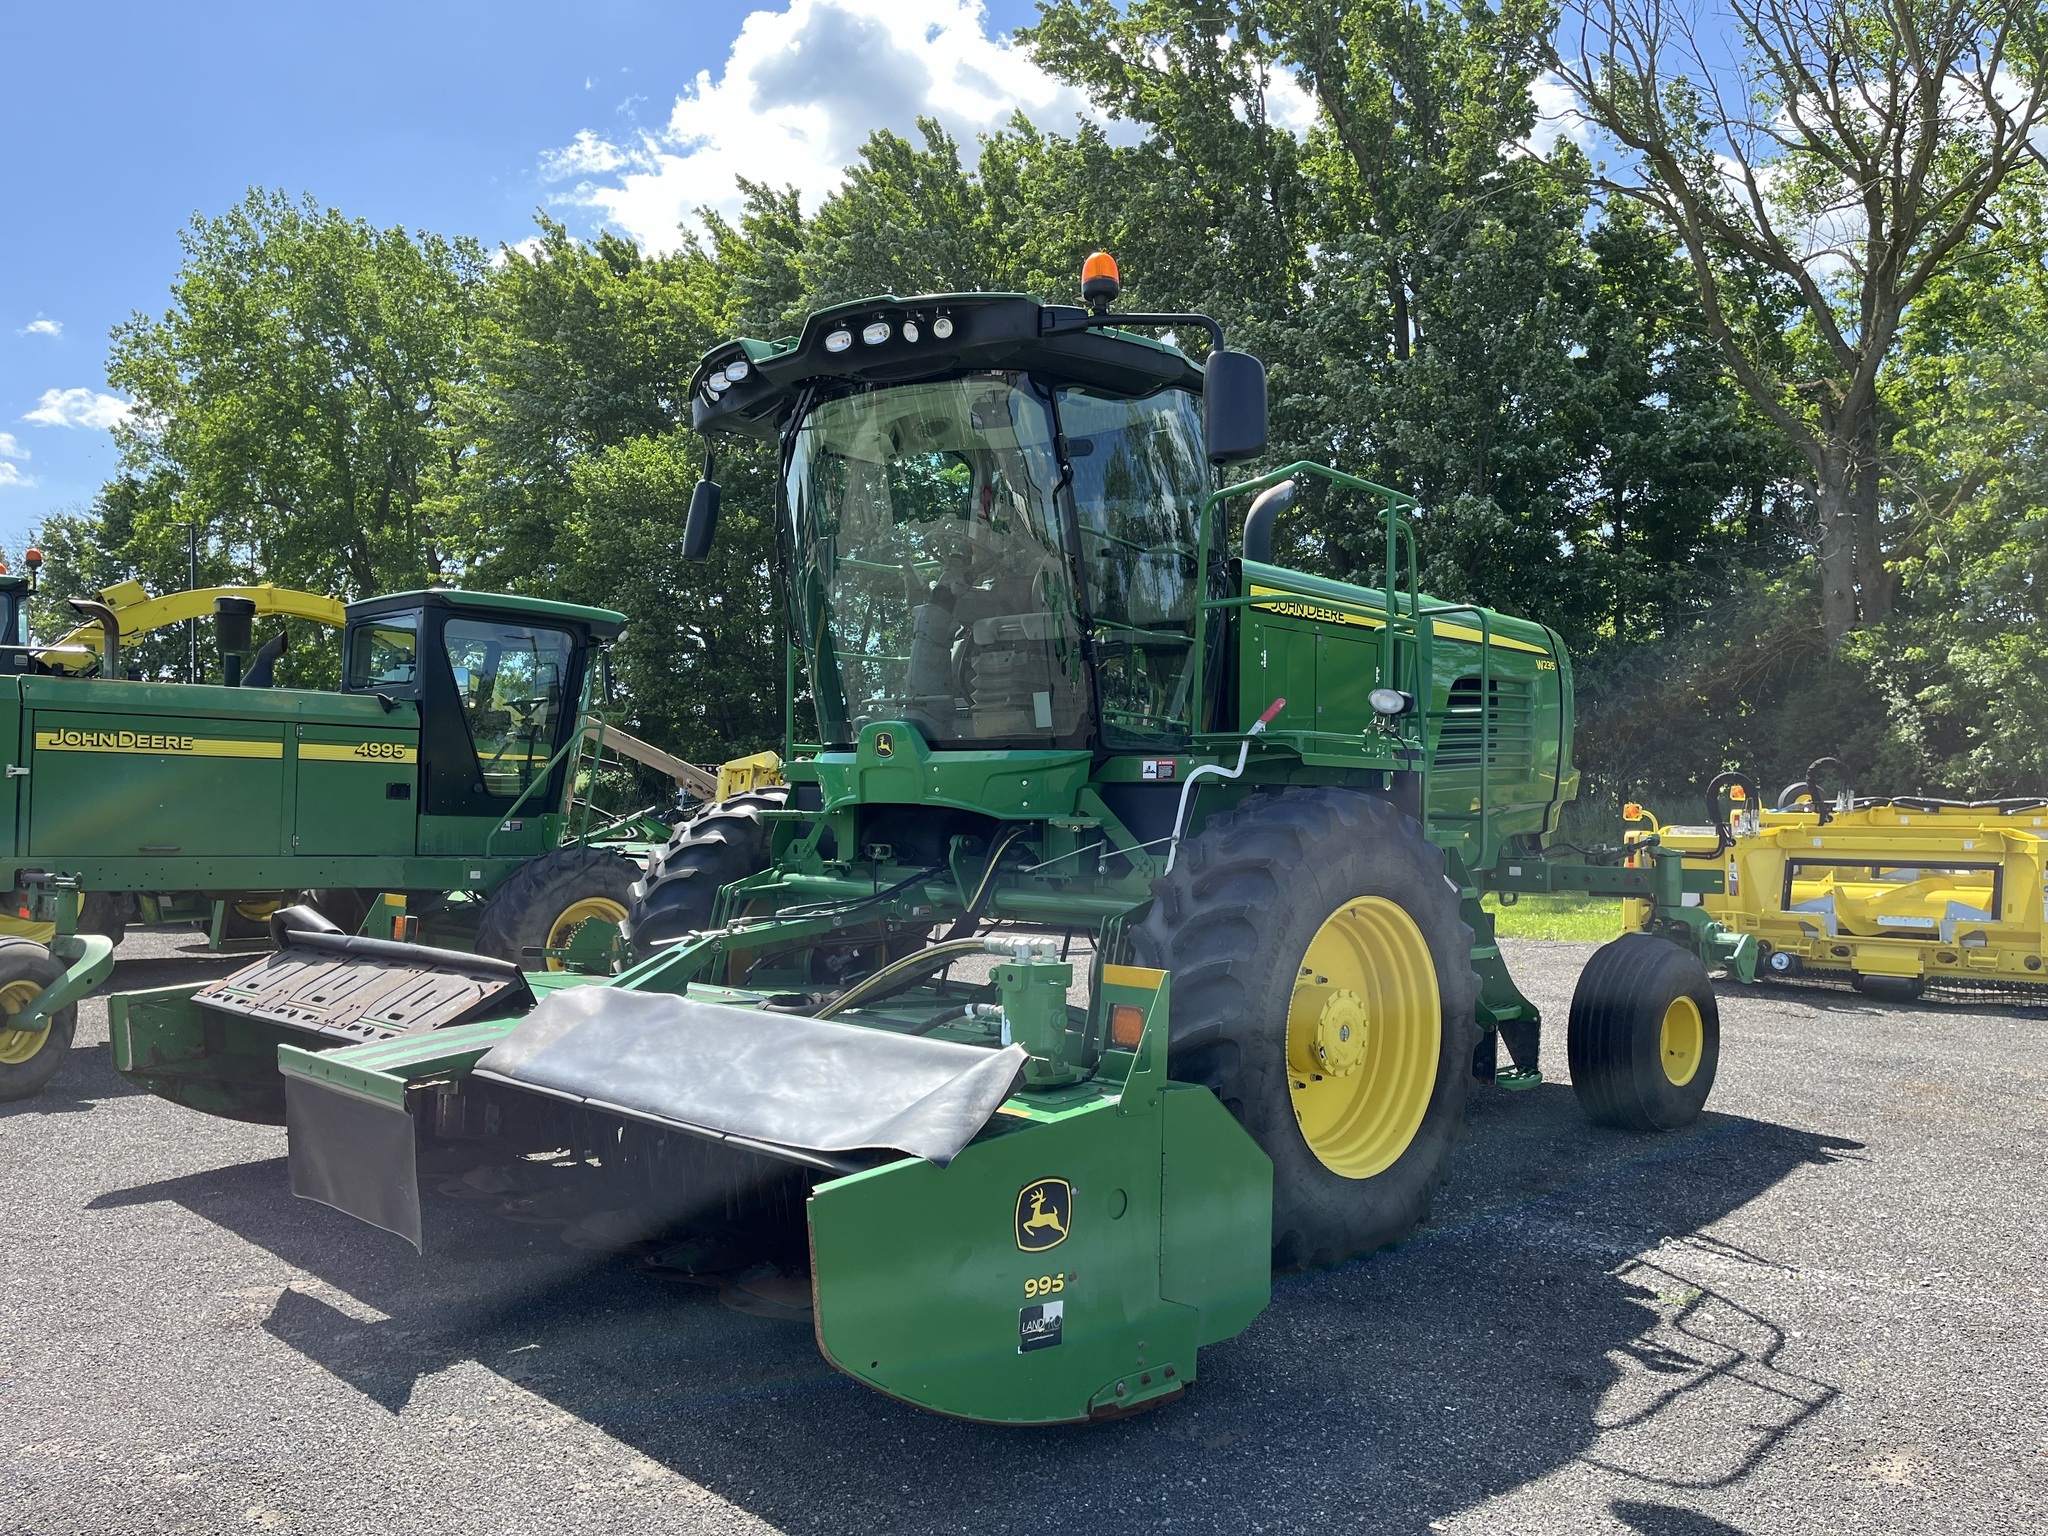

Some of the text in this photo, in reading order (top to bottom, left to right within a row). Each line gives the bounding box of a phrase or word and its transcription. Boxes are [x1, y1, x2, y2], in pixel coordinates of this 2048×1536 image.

[1307, 605, 1346, 624] DEERE
[1535, 659, 1556, 671] W235
[50, 728, 194, 750] JOHN DEERE
[355, 742, 406, 759] 4995
[1024, 1272, 1065, 1298] 995
